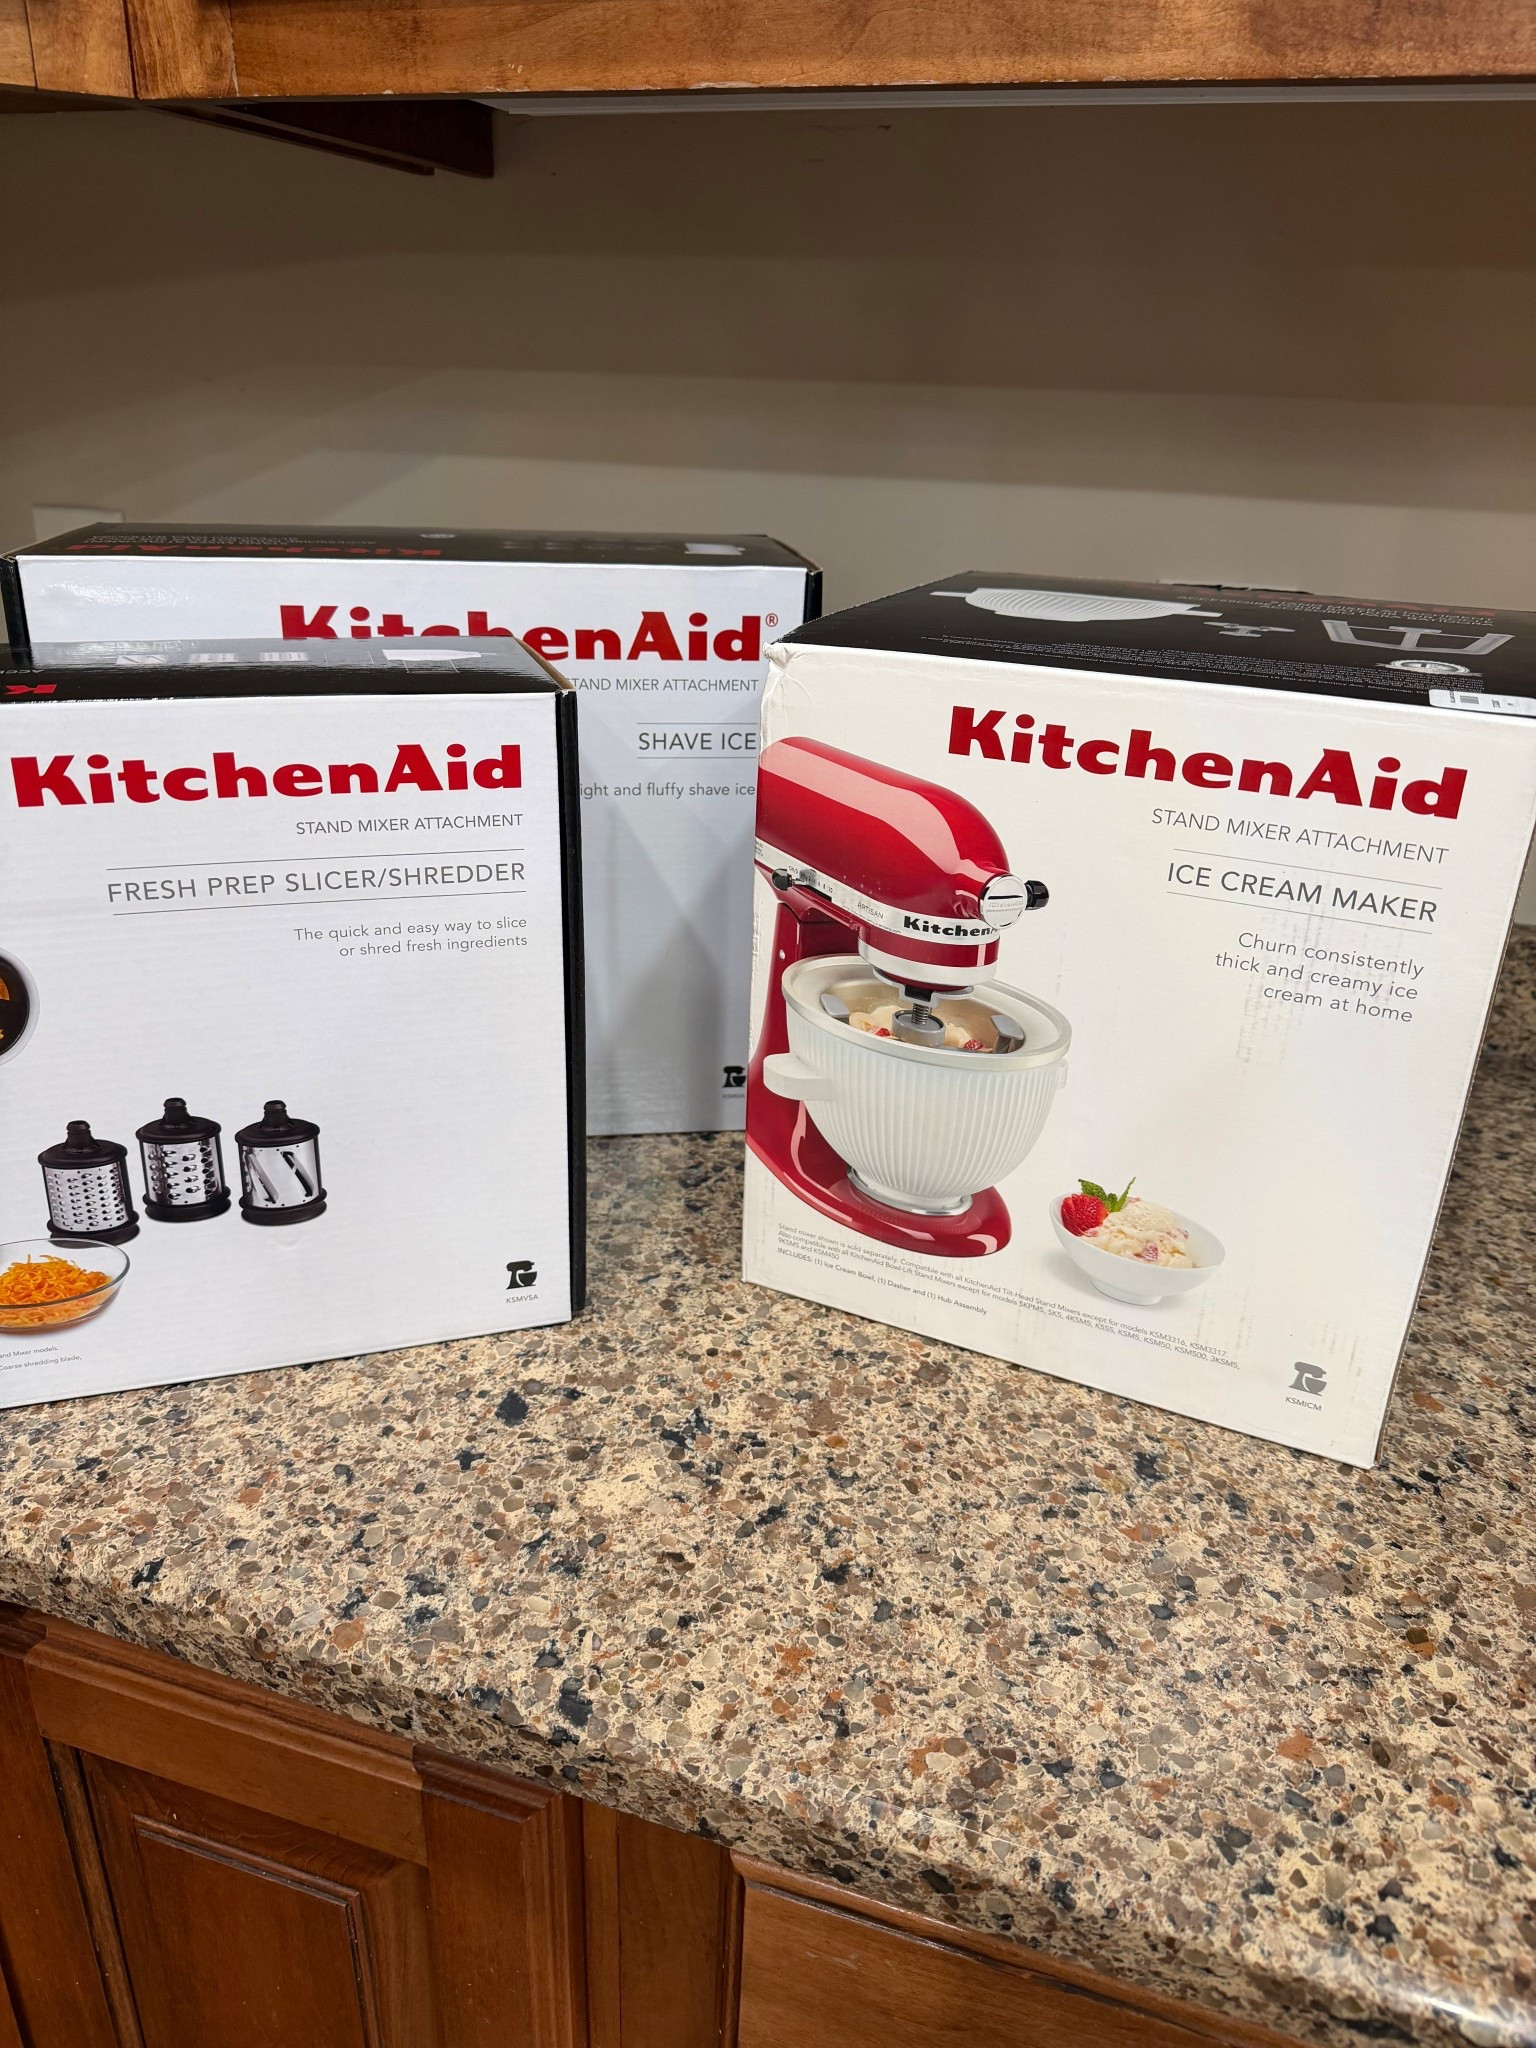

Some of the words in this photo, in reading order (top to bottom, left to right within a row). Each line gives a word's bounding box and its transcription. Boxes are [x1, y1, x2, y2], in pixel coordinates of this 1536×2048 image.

[567, 678, 612, 691] TAND
[616, 678, 659, 691] MIXER
[663, 679, 760, 692] ATTACHMENT
[638, 732, 713, 751] SHAVE
[721, 732, 757, 751] ICE
[10, 743, 522, 807] KitchenAid
[948, 705, 1468, 820] KitchenAid
[580, 782, 609, 800] ight
[614, 782, 642, 796] and
[646, 782, 685, 799] fluffy
[689, 783, 731, 796] shave
[735, 783, 756, 796] ice
[296, 820, 353, 835] STAND
[358, 818, 409, 833] MIXER
[414, 813, 524, 830] ATTACHMENT
[1151, 808, 1220, 831] STAND
[1227, 818, 1291, 842] MIXER
[1295, 828, 1450, 864] ATTACHMENT
[108, 878, 197, 903] FRESH
[207, 873, 275, 897] PREP
[285, 862, 527, 894] SLICER/SHREDDER
[1167, 862, 1212, 888] ICE
[1220, 870, 1323, 905] CREAM
[1331, 887, 1438, 923] MAKER
[293, 928, 323, 941] The
[328, 924, 369, 942] quick
[374, 922, 402, 936] and
[407, 923, 440, 936] easy
[444, 920, 473, 934] way
[477, 918, 492, 931] to
[496, 916, 528, 930] slice
[903, 915, 998, 937] Kitchen
[339, 946, 355, 957] or
[360, 940, 402, 956] shred
[406, 938, 442, 953] fresh
[447, 935, 528, 953] ingredients
[1238, 932, 1297, 956] Churn
[1304, 947, 1425, 980] consistently
[1215, 951, 1260, 973] thick
[1266, 964, 1304, 980] and
[1310, 970, 1383, 997] creamy
[1389, 981, 1418, 1000] ice
[1263, 987, 1323, 1007] cream
[1329, 998, 1350, 1012] at
[1355, 998, 1413, 1023] home
[800, 1244, 813, 1253] and
[777, 1247, 813, 1263] INCLUDES:
[824, 1260, 834, 1269] Ice
[835, 1264, 857, 1276] Cream
[887, 1279, 911, 1292] Dasher
[912, 1287, 926, 1296] and
[937, 1294, 952, 1304] Hub
[953, 1299, 988, 1316] Assembly
[778, 1222, 797, 1233] Stand
[799, 1229, 817, 1239] mixer
[818, 1235, 839, 1246] shown
[847, 1243, 861, 1252] sold
[901, 1258, 938, 1274] Compatible
[940, 1270, 954, 1278] with
[964, 1277, 1001, 1293] KitchenAid
[1035, 1297, 1055, 1309] Stand
[1057, 1304, 1081, 1316] Mixers
[1082, 1312, 1107, 1324] except
[1108, 1318, 1119, 1327] for
[1120, 1322, 1148, 1335] models
[914, 1269, 933, 1281] Stand
[934, 1276, 956, 1288] Mixers
[957, 1283, 980, 1296] except
[981, 1289, 991, 1298] for
[992, 1294, 1018, 1306] models
[24, 1358, 59, 1368] shredding
[1285, 1395, 1322, 1411] KSMICM
